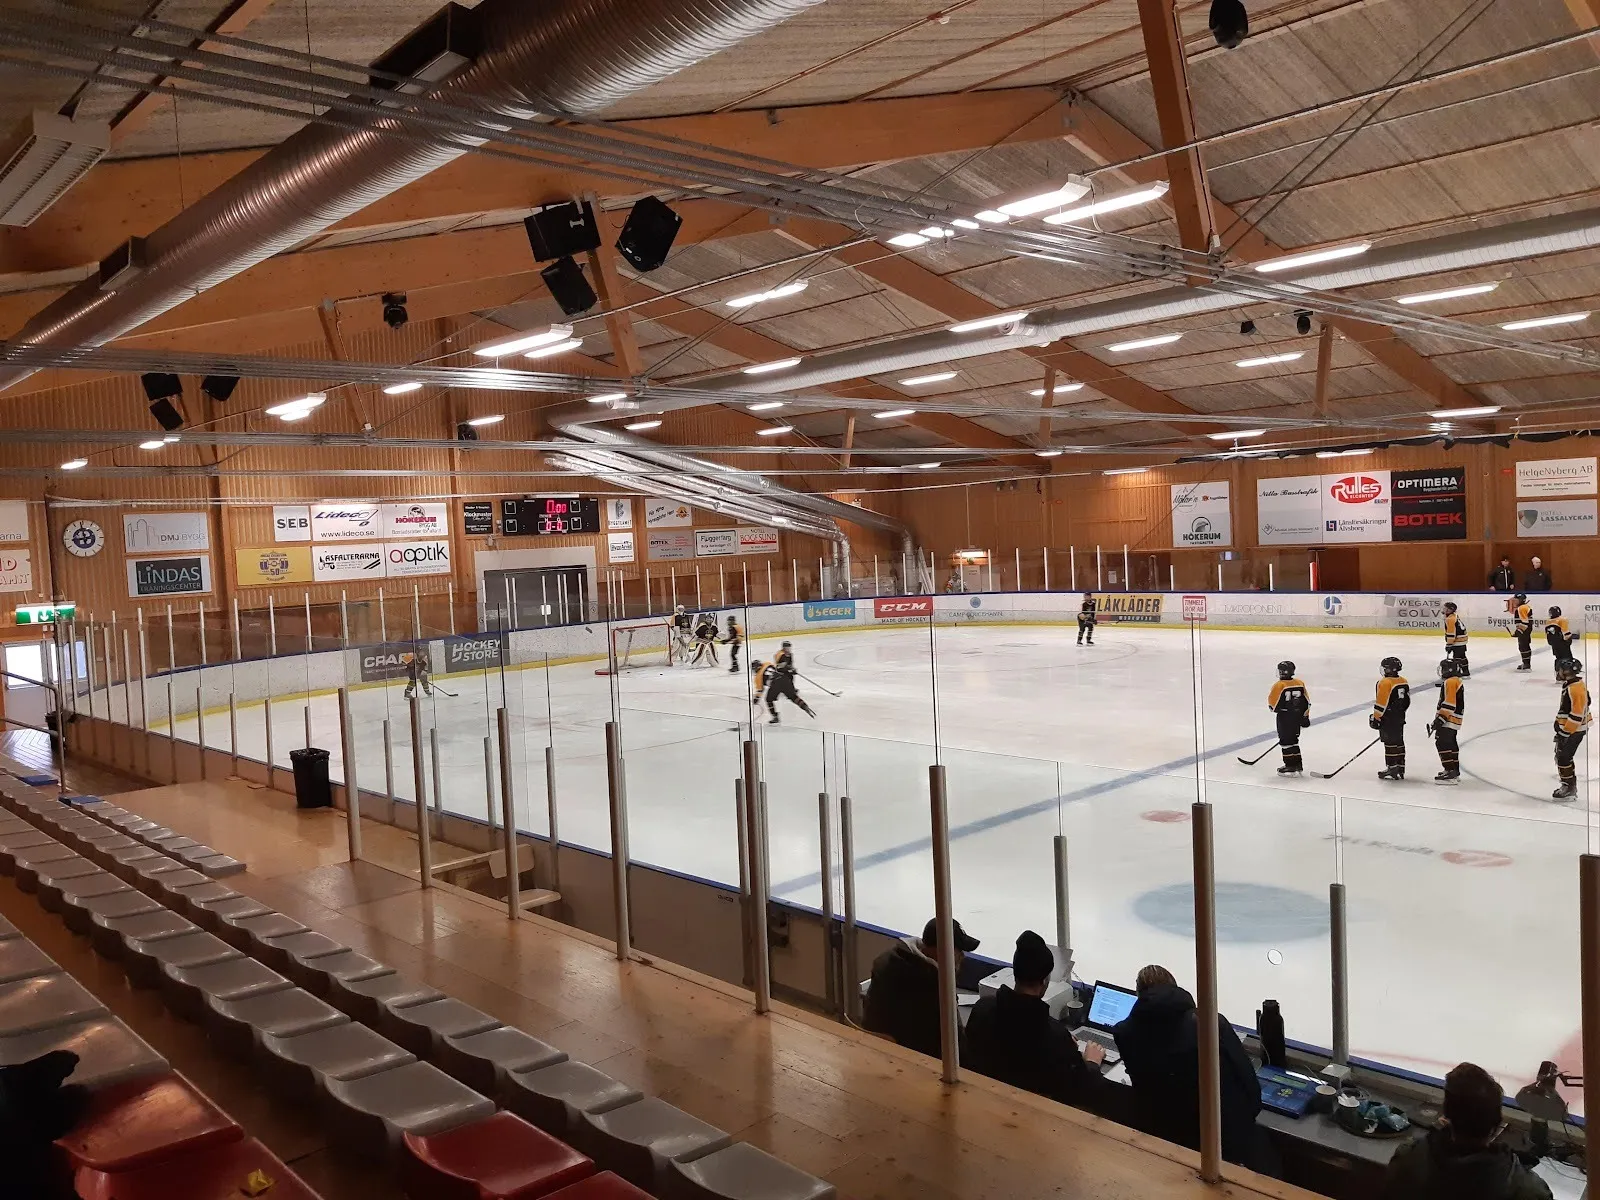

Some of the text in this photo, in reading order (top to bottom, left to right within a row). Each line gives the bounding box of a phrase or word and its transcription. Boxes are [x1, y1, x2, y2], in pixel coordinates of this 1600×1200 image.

[1580, 465, 1594, 474] AB
[1330, 475, 1382, 499] Rulles
[1397, 477, 1458, 489] OPTIMERA
[1393, 512, 1464, 527] BOTEK
[160, 533, 206, 542] DMJ BYGG
[320, 530, 375, 538] www.lideco.se
[1182, 532, 1221, 541] HÖKERUM
[325, 552, 381, 562] ASFALTERARNA
[880, 602, 927, 612] CCM
[1397, 609, 1441, 618] GOLV
[1398, 620, 1441, 628] BADRUM
[364, 652, 414, 668] CRAF
[463, 648, 499, 662] STORE
